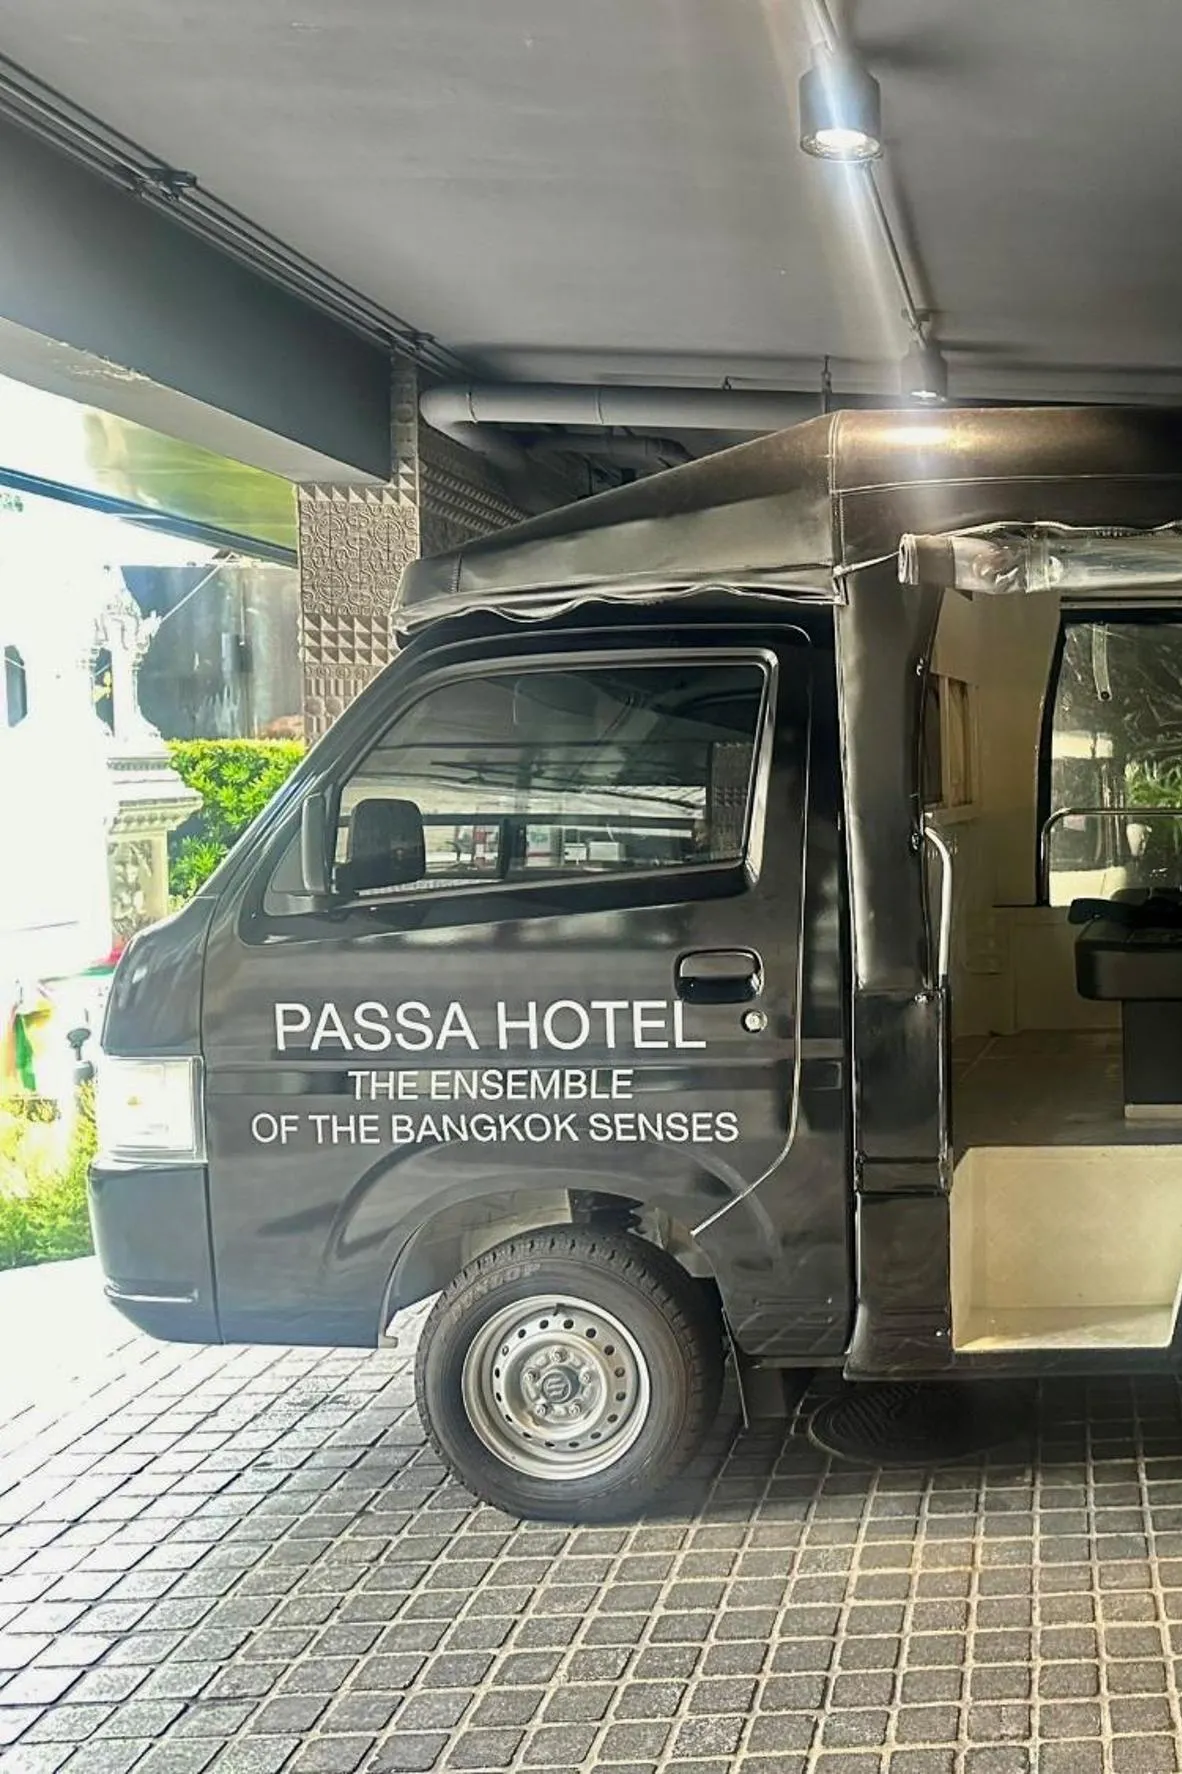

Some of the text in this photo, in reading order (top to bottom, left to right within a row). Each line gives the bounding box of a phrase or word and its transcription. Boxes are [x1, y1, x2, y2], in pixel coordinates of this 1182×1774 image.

[274, 1000, 707, 1052] PASSA HOTEL
[347, 1068, 634, 1102] THE ENSEMBLE
[251, 1111, 739, 1145] OF THE BANGKOK SENSES
